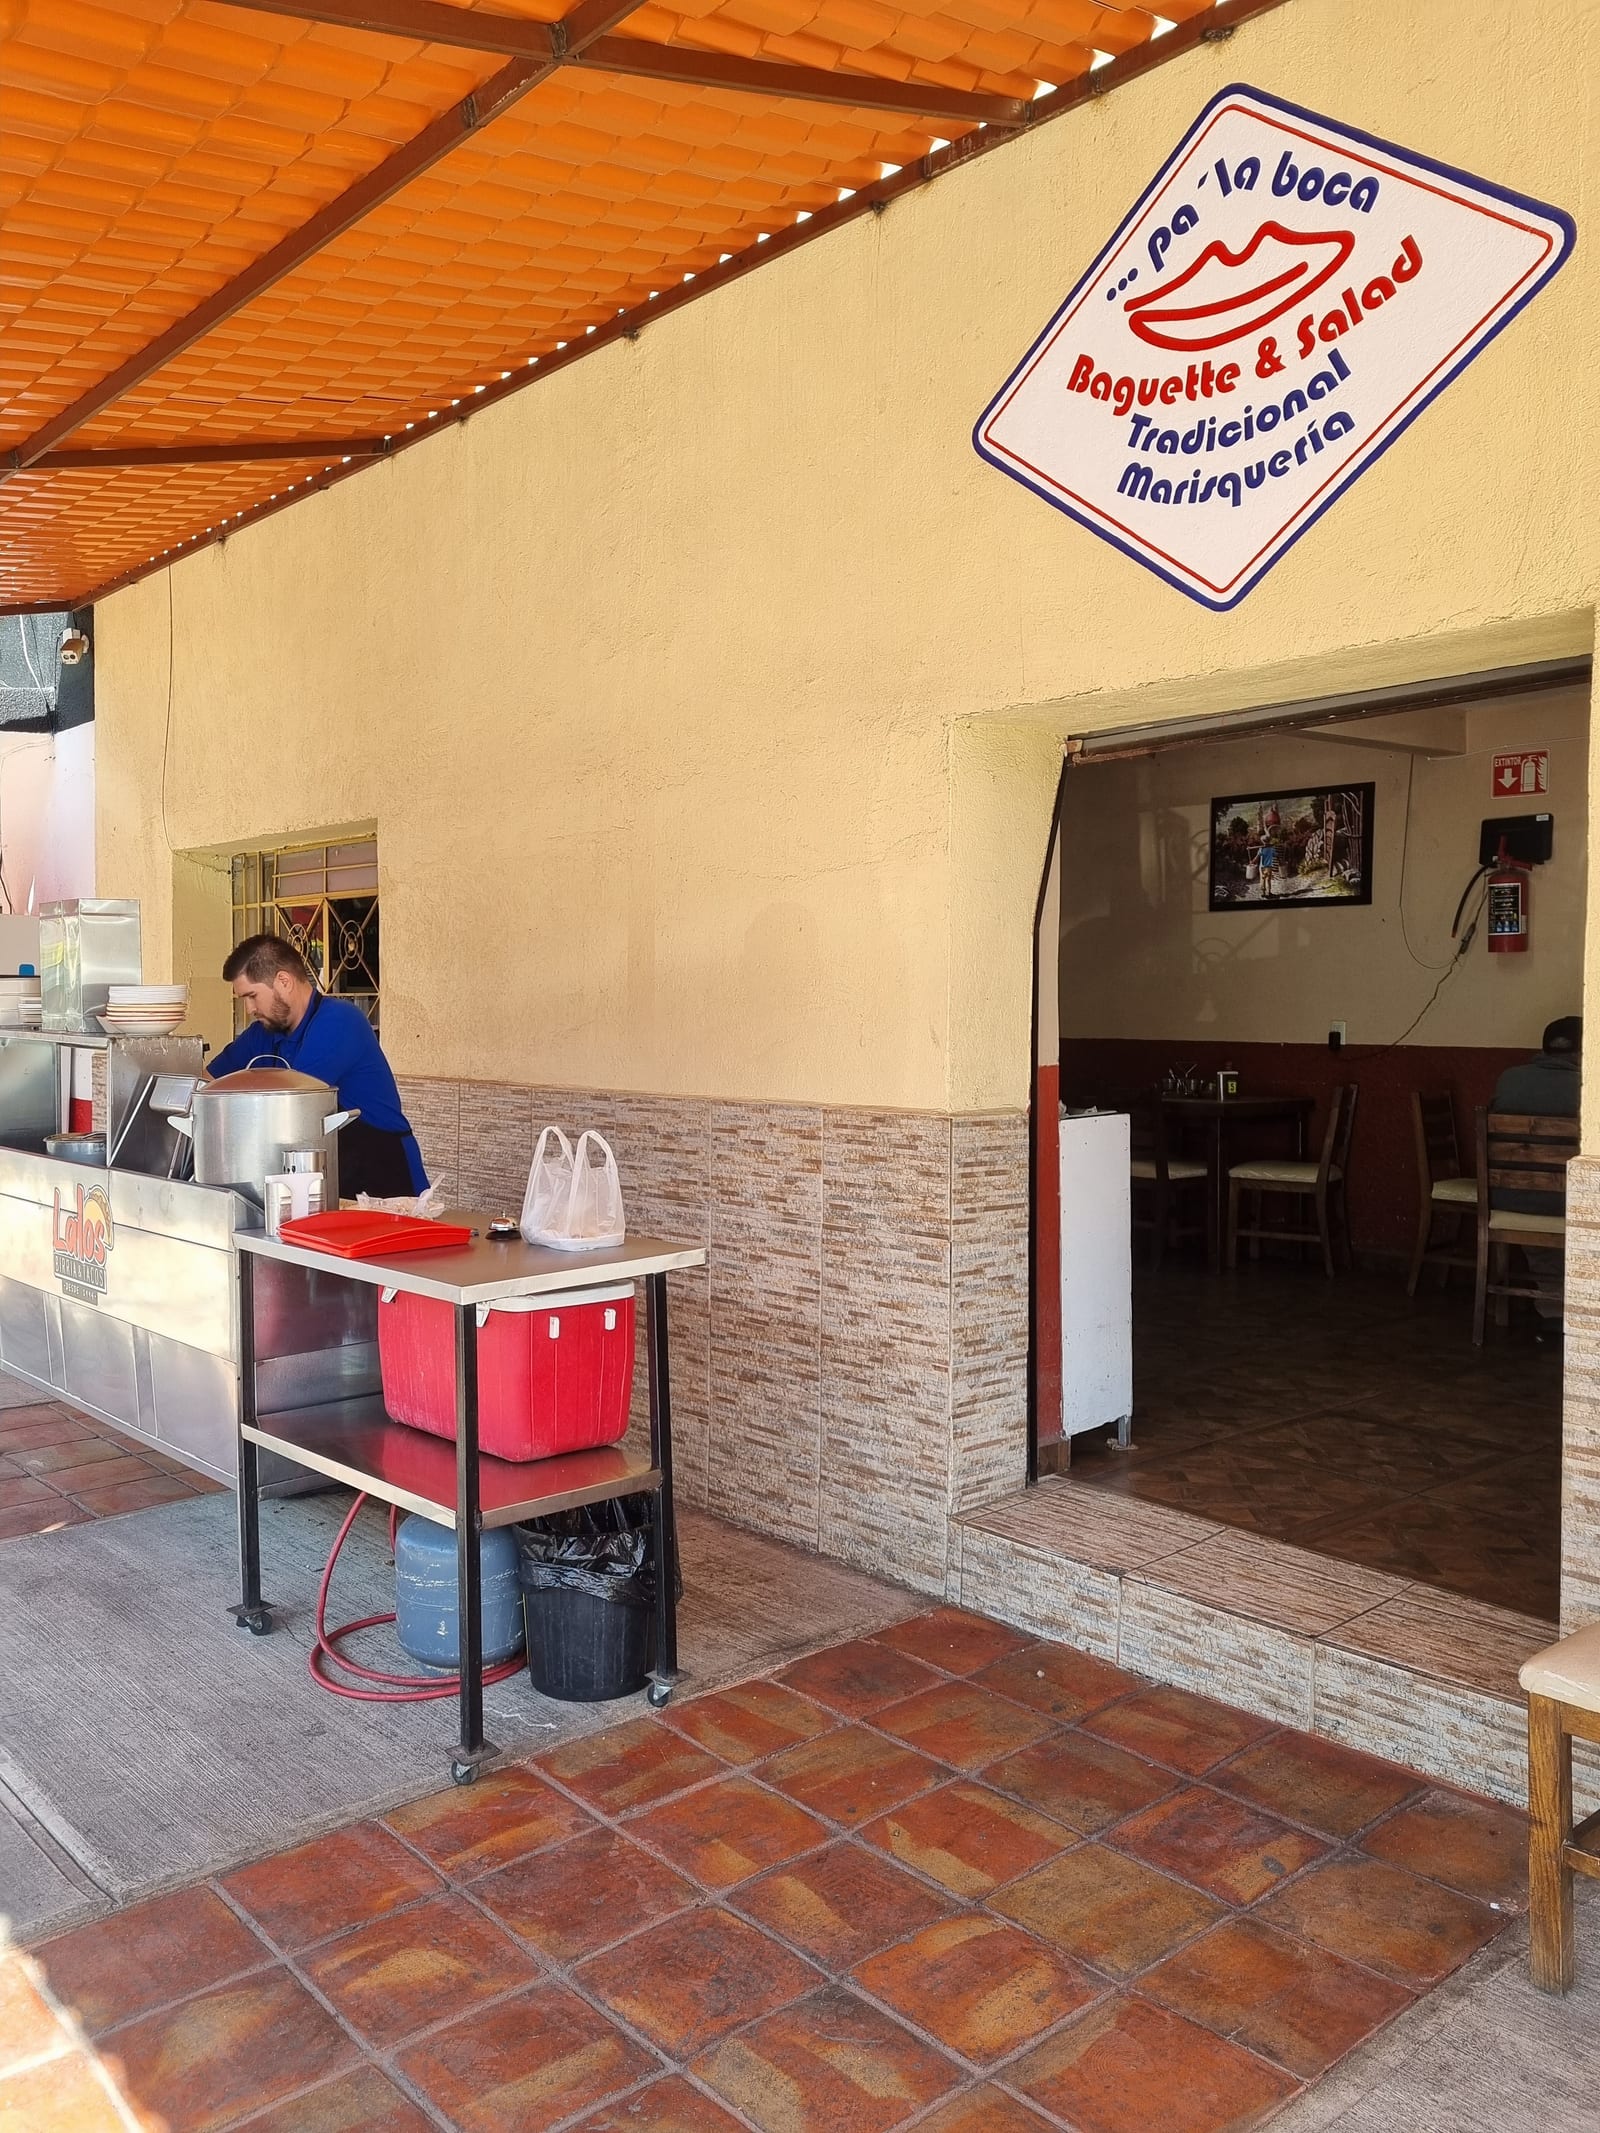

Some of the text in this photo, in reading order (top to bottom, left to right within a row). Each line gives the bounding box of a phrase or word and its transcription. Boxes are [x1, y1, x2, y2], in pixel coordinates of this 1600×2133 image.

[1272, 151, 1380, 213] boca
[1066, 234, 1423, 417] Baguette & Salad
[1128, 348, 1352, 456] Tradicional
[1116, 407, 1355, 508] Marisquería
[1495, 757, 1521, 767] EXTINTOR
[55, 1255, 77, 1278] BIRRIA
[82, 1263, 104, 1288] TACOS
